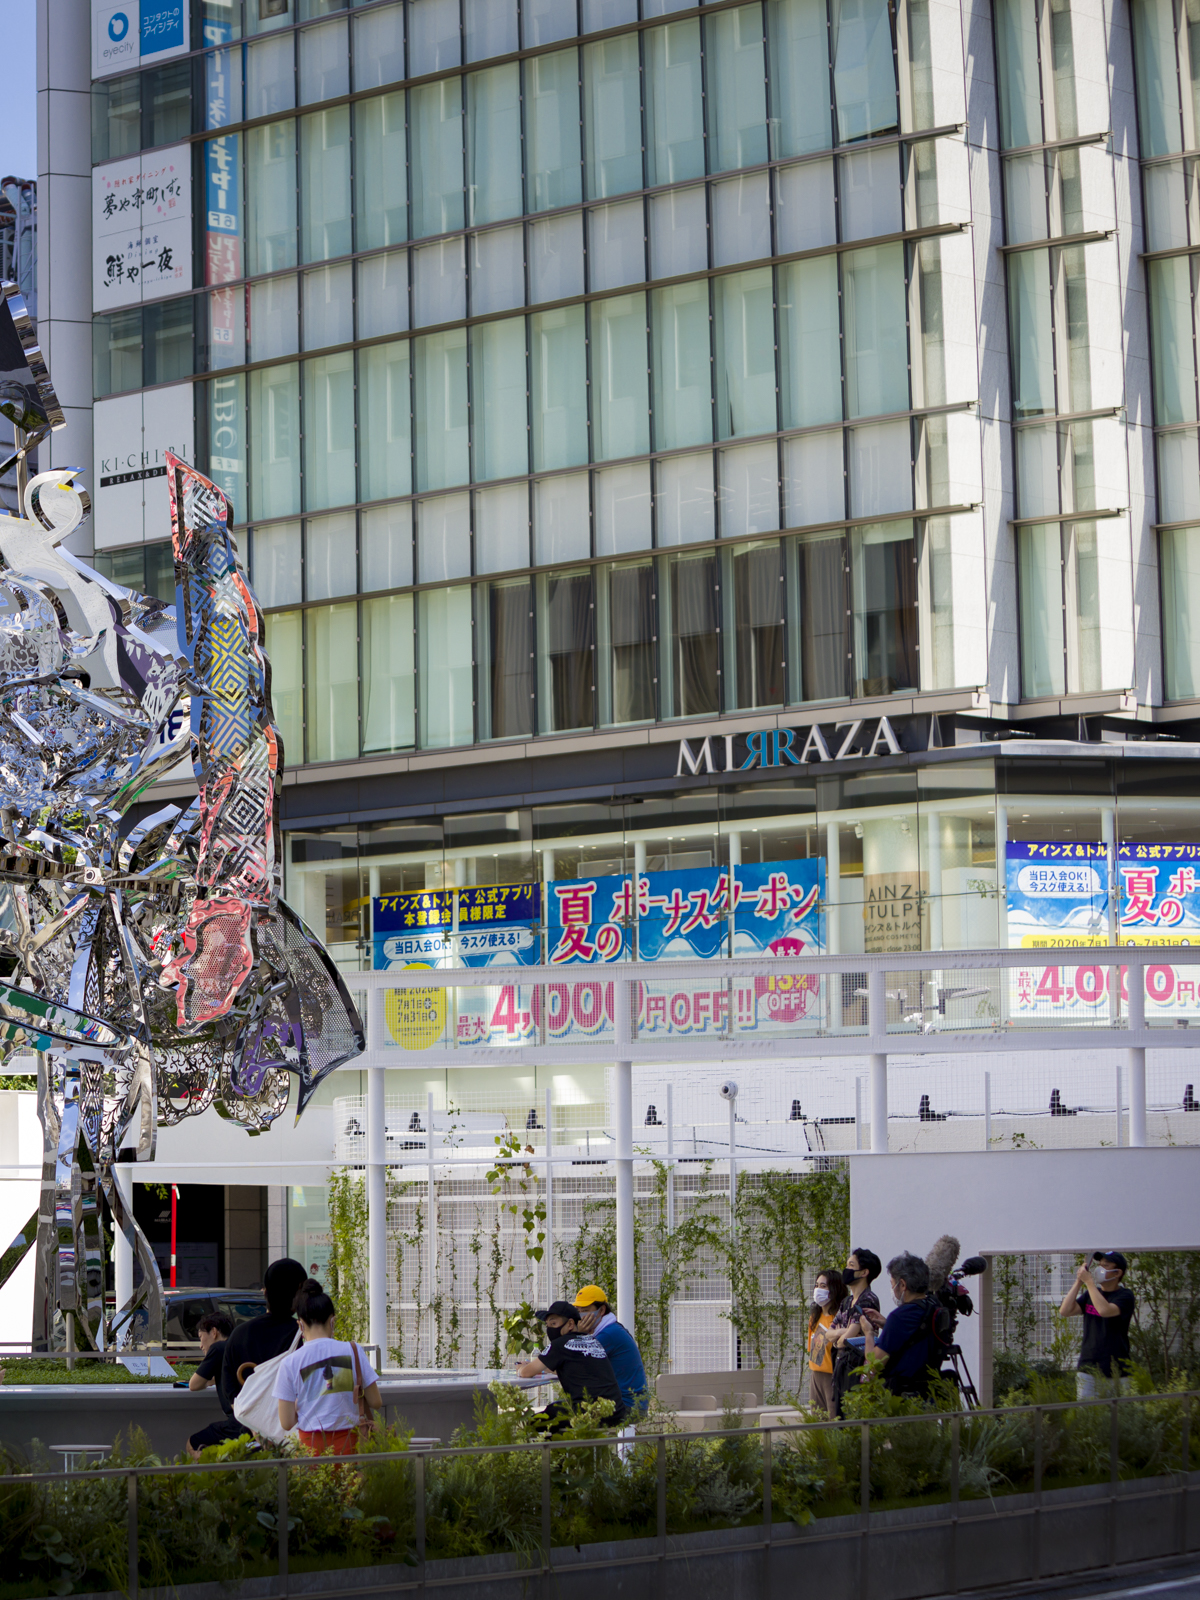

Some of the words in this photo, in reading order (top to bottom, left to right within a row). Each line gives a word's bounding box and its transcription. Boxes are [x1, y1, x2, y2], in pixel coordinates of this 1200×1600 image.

[144, 8, 179, 25] コンタクトの
[144, 19, 179, 38] アイシティ
[103, 42, 134, 59] eyecity
[103, 246, 173, 287] 鮮や一夜
[109, 467, 166, 485] RELAX&DI
[1028, 844, 1131, 857] アインズ&トルペ
[1136, 845, 1200, 858] 公式アプリ
[1029, 870, 1087, 881] 当日入会OK!
[475, 885, 533, 904] 公式アプリ
[869, 884, 912, 901] AINZ
[1029, 882, 1089, 893] 今スグ使える!
[404, 904, 507, 926] 本登録会員様限定
[869, 903, 926, 919] TULPE
[460, 932, 520, 949] 今スグ使える!
[769, 990, 806, 1012] OFF!
